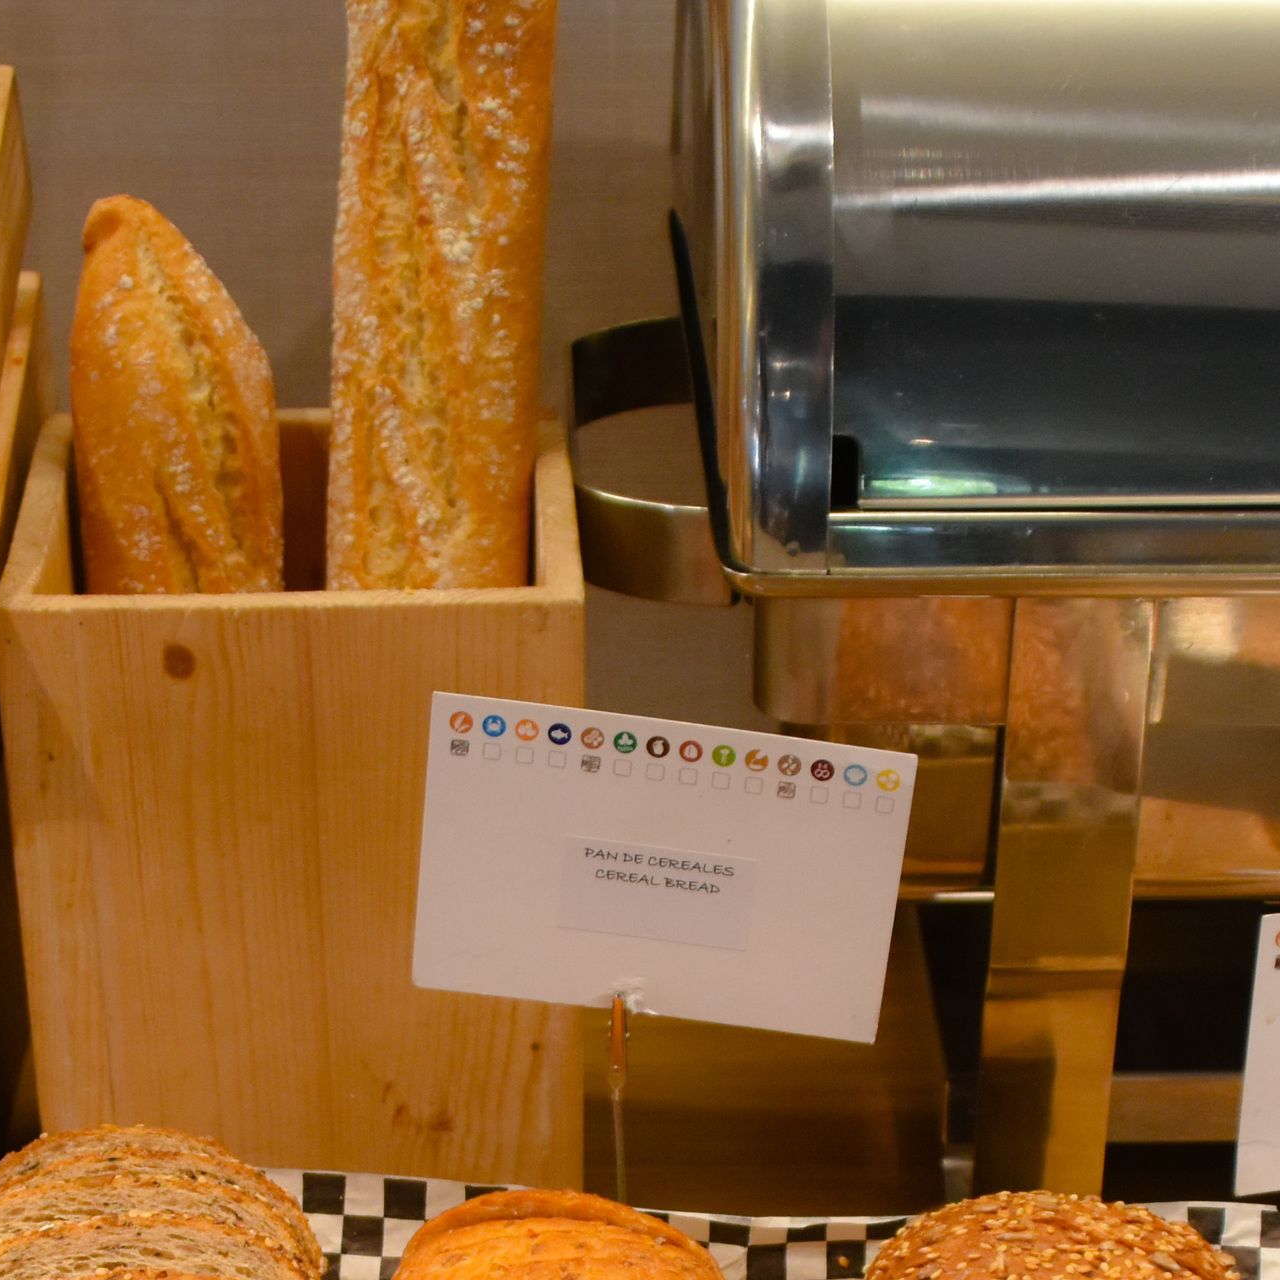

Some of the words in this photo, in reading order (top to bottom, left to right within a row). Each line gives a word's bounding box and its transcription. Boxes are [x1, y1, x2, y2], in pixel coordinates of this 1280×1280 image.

[583, 847, 619, 861] PAN
[623, 852, 644, 864] DE
[647, 856, 735, 877] CEREALES
[595, 868, 661, 886] CEREAL
[664, 877, 721, 894] BREAD
